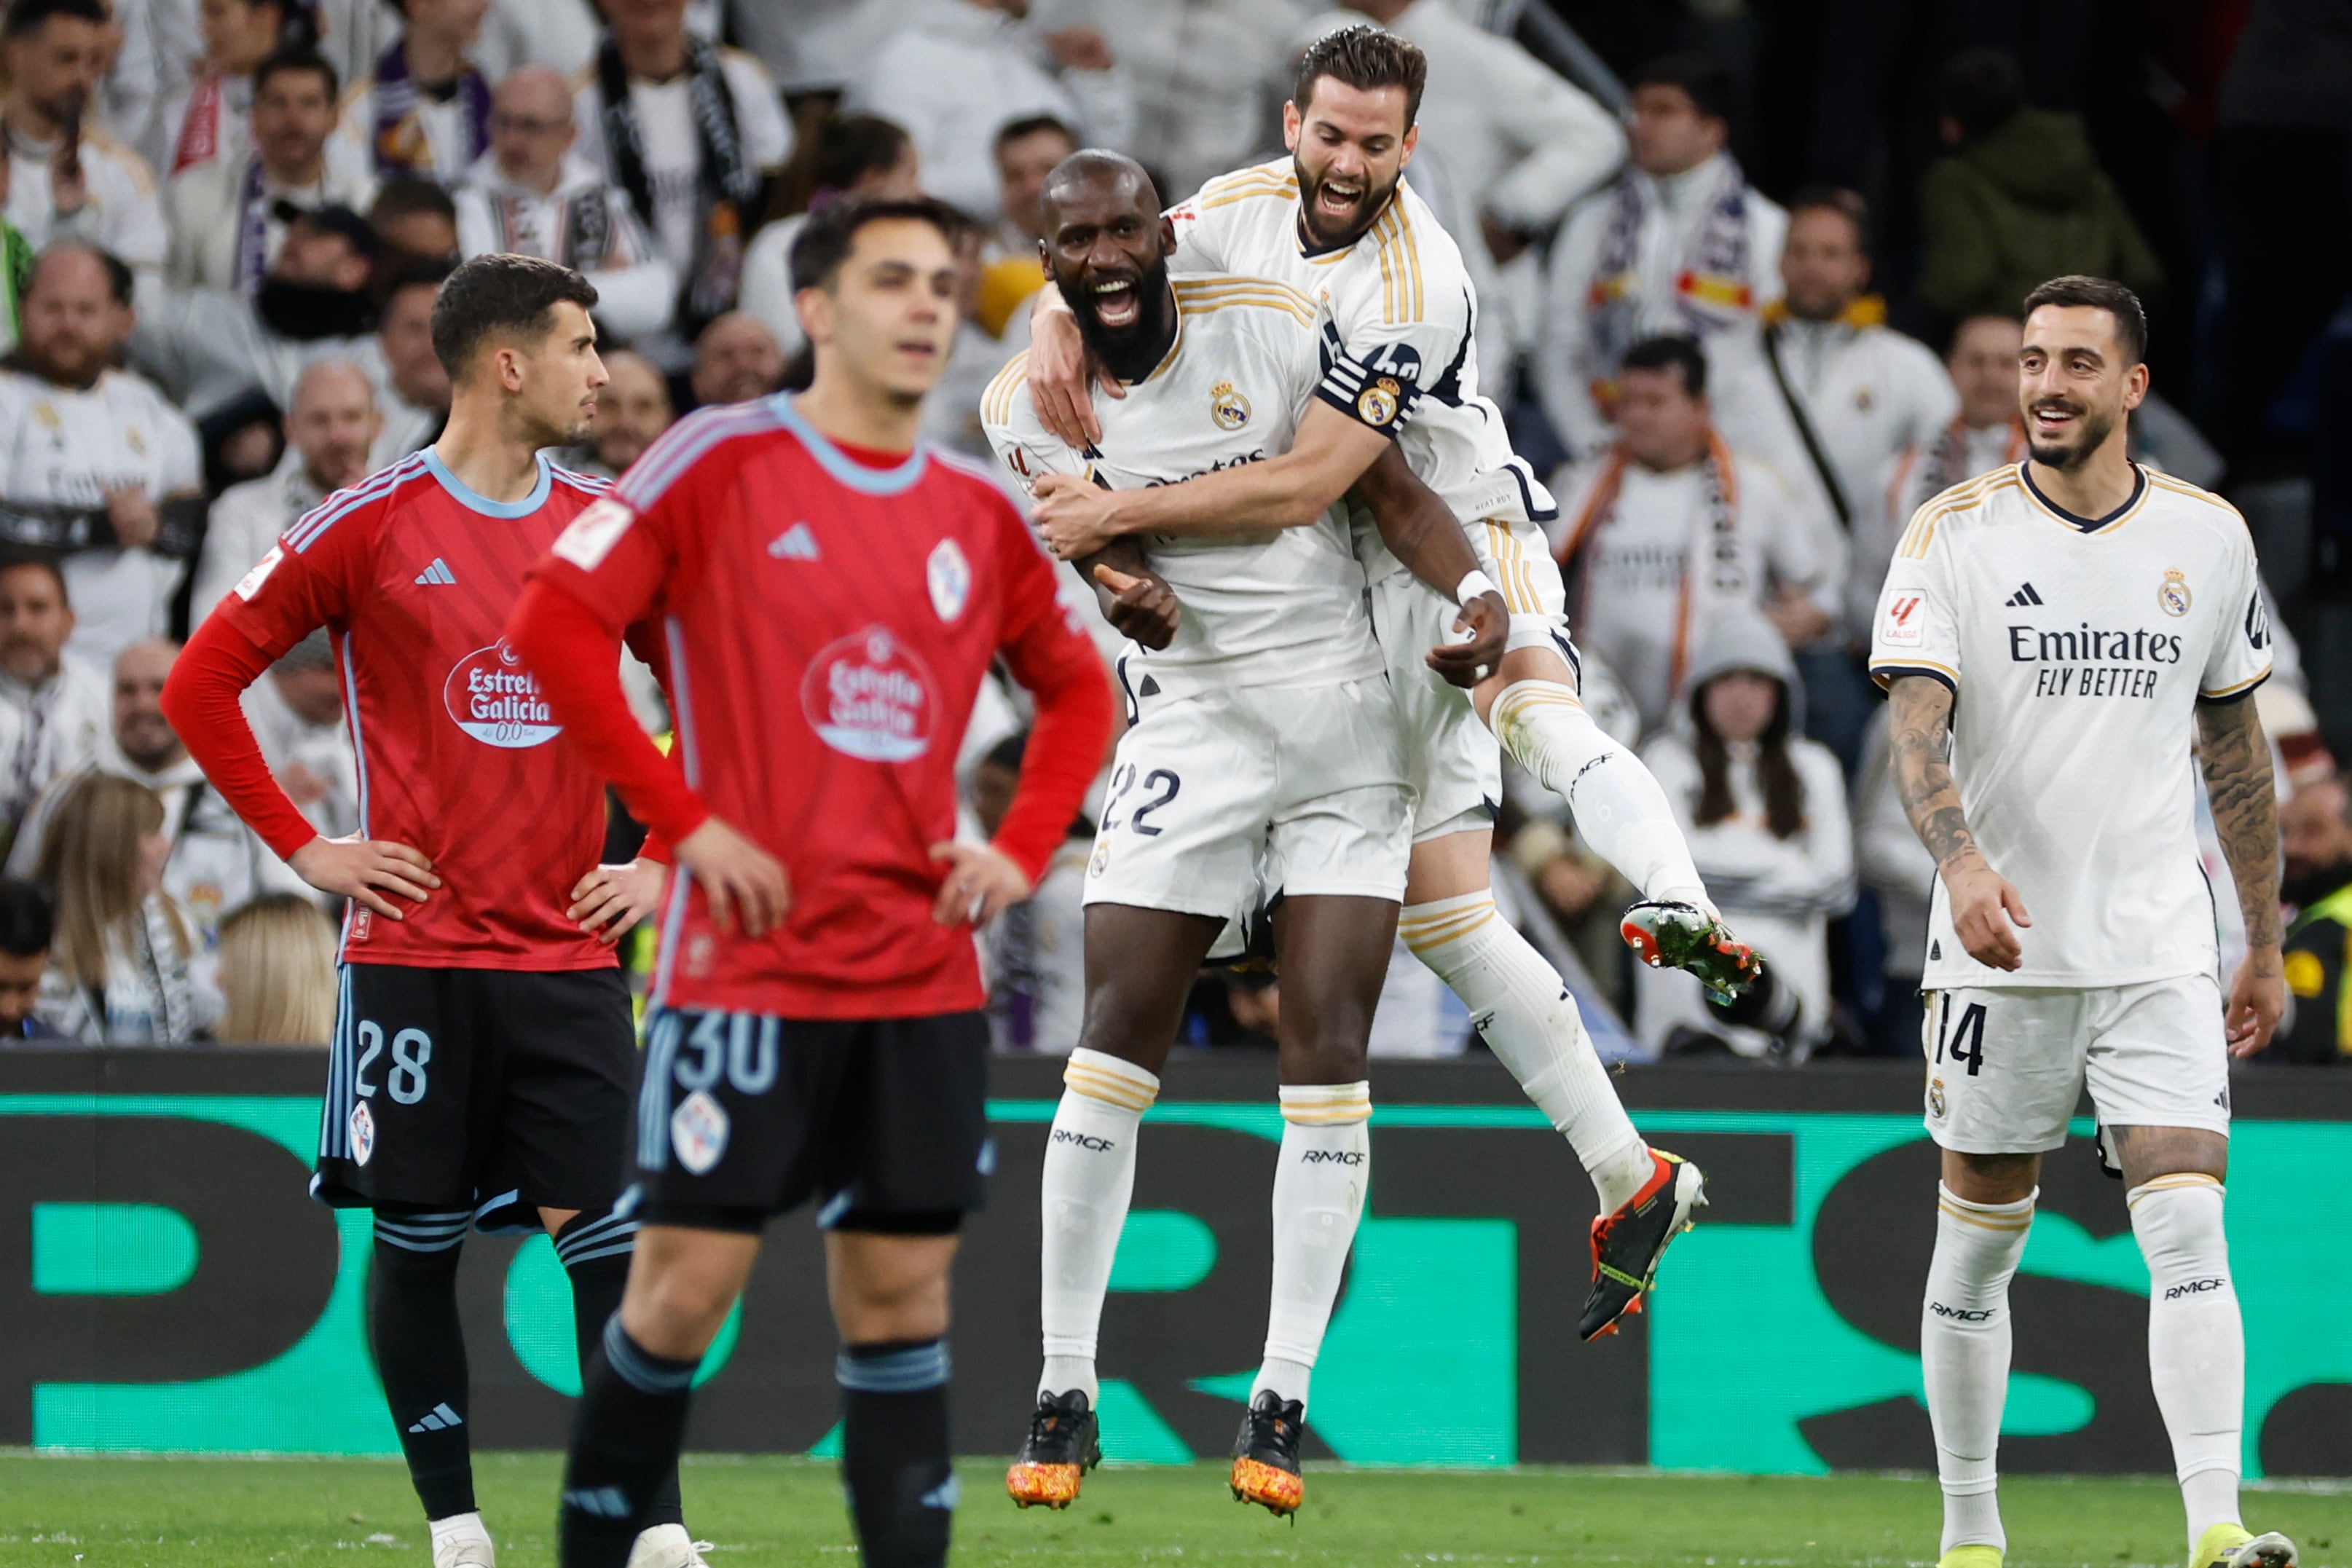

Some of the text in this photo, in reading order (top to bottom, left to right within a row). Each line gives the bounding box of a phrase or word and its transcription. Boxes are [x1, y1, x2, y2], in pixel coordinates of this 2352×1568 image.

[1886, 630, 1917, 639] LALIGA
[2007, 623, 2182, 664] Emirates
[467, 667, 540, 694] Estrel
[2036, 668, 2158, 698] FLY BETTER
[471, 693, 550, 721] Galicia
[1101, 763, 1180, 836] 22
[1935, 993, 1987, 1076] 14
[355, 1020, 431, 1104] 28
[674, 1008, 778, 1094] 30
[1052, 1129, 1114, 1153] RMCF
[1302, 1149, 1365, 1167] RMCF
[2165, 1278, 2226, 1301] RMCF
[1929, 1301, 1997, 1322] RMCF
